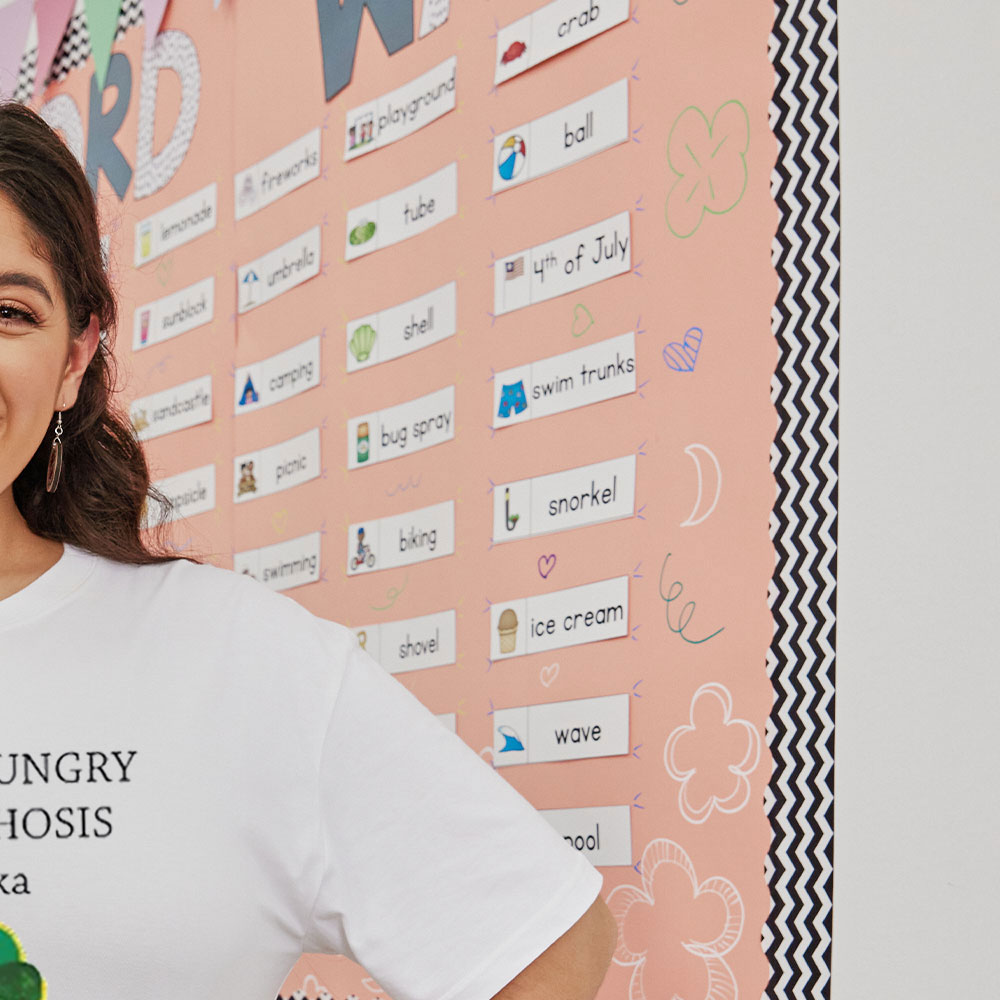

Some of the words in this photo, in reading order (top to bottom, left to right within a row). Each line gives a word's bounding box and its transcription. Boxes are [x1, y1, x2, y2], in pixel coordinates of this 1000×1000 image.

[557, 0, 600, 37] crab
[377, 66, 457, 136] playground
[564, 110, 594, 148] ball
[261, 146, 318, 194] fireworks
[161, 200, 213, 242] lemonade
[403, 194, 436, 225] tube
[266, 246, 316, 288] umbrella
[533, 250, 558, 284] 4th
[564, 243, 586, 276] of
[592, 229, 629, 264] July
[162, 290, 207, 330] sunblock
[403, 305, 434, 341] shell
[268, 360, 315, 392] camping
[531, 374, 574, 400] swim
[580, 351, 636, 386] trunks
[152, 385, 211, 423] sandcastle
[380, 424, 408, 449] bug
[412, 411, 453, 442] spray
[275, 455, 307, 485] picnic
[548, 474, 618, 517] snorkel
[399, 525, 438, 552] biking
[262, 553, 317, 583] swimming
[531, 617, 556, 639] ice
[563, 603, 624, 632] cream
[399, 626, 440, 659] shovel
[554, 724, 602, 745] wave
